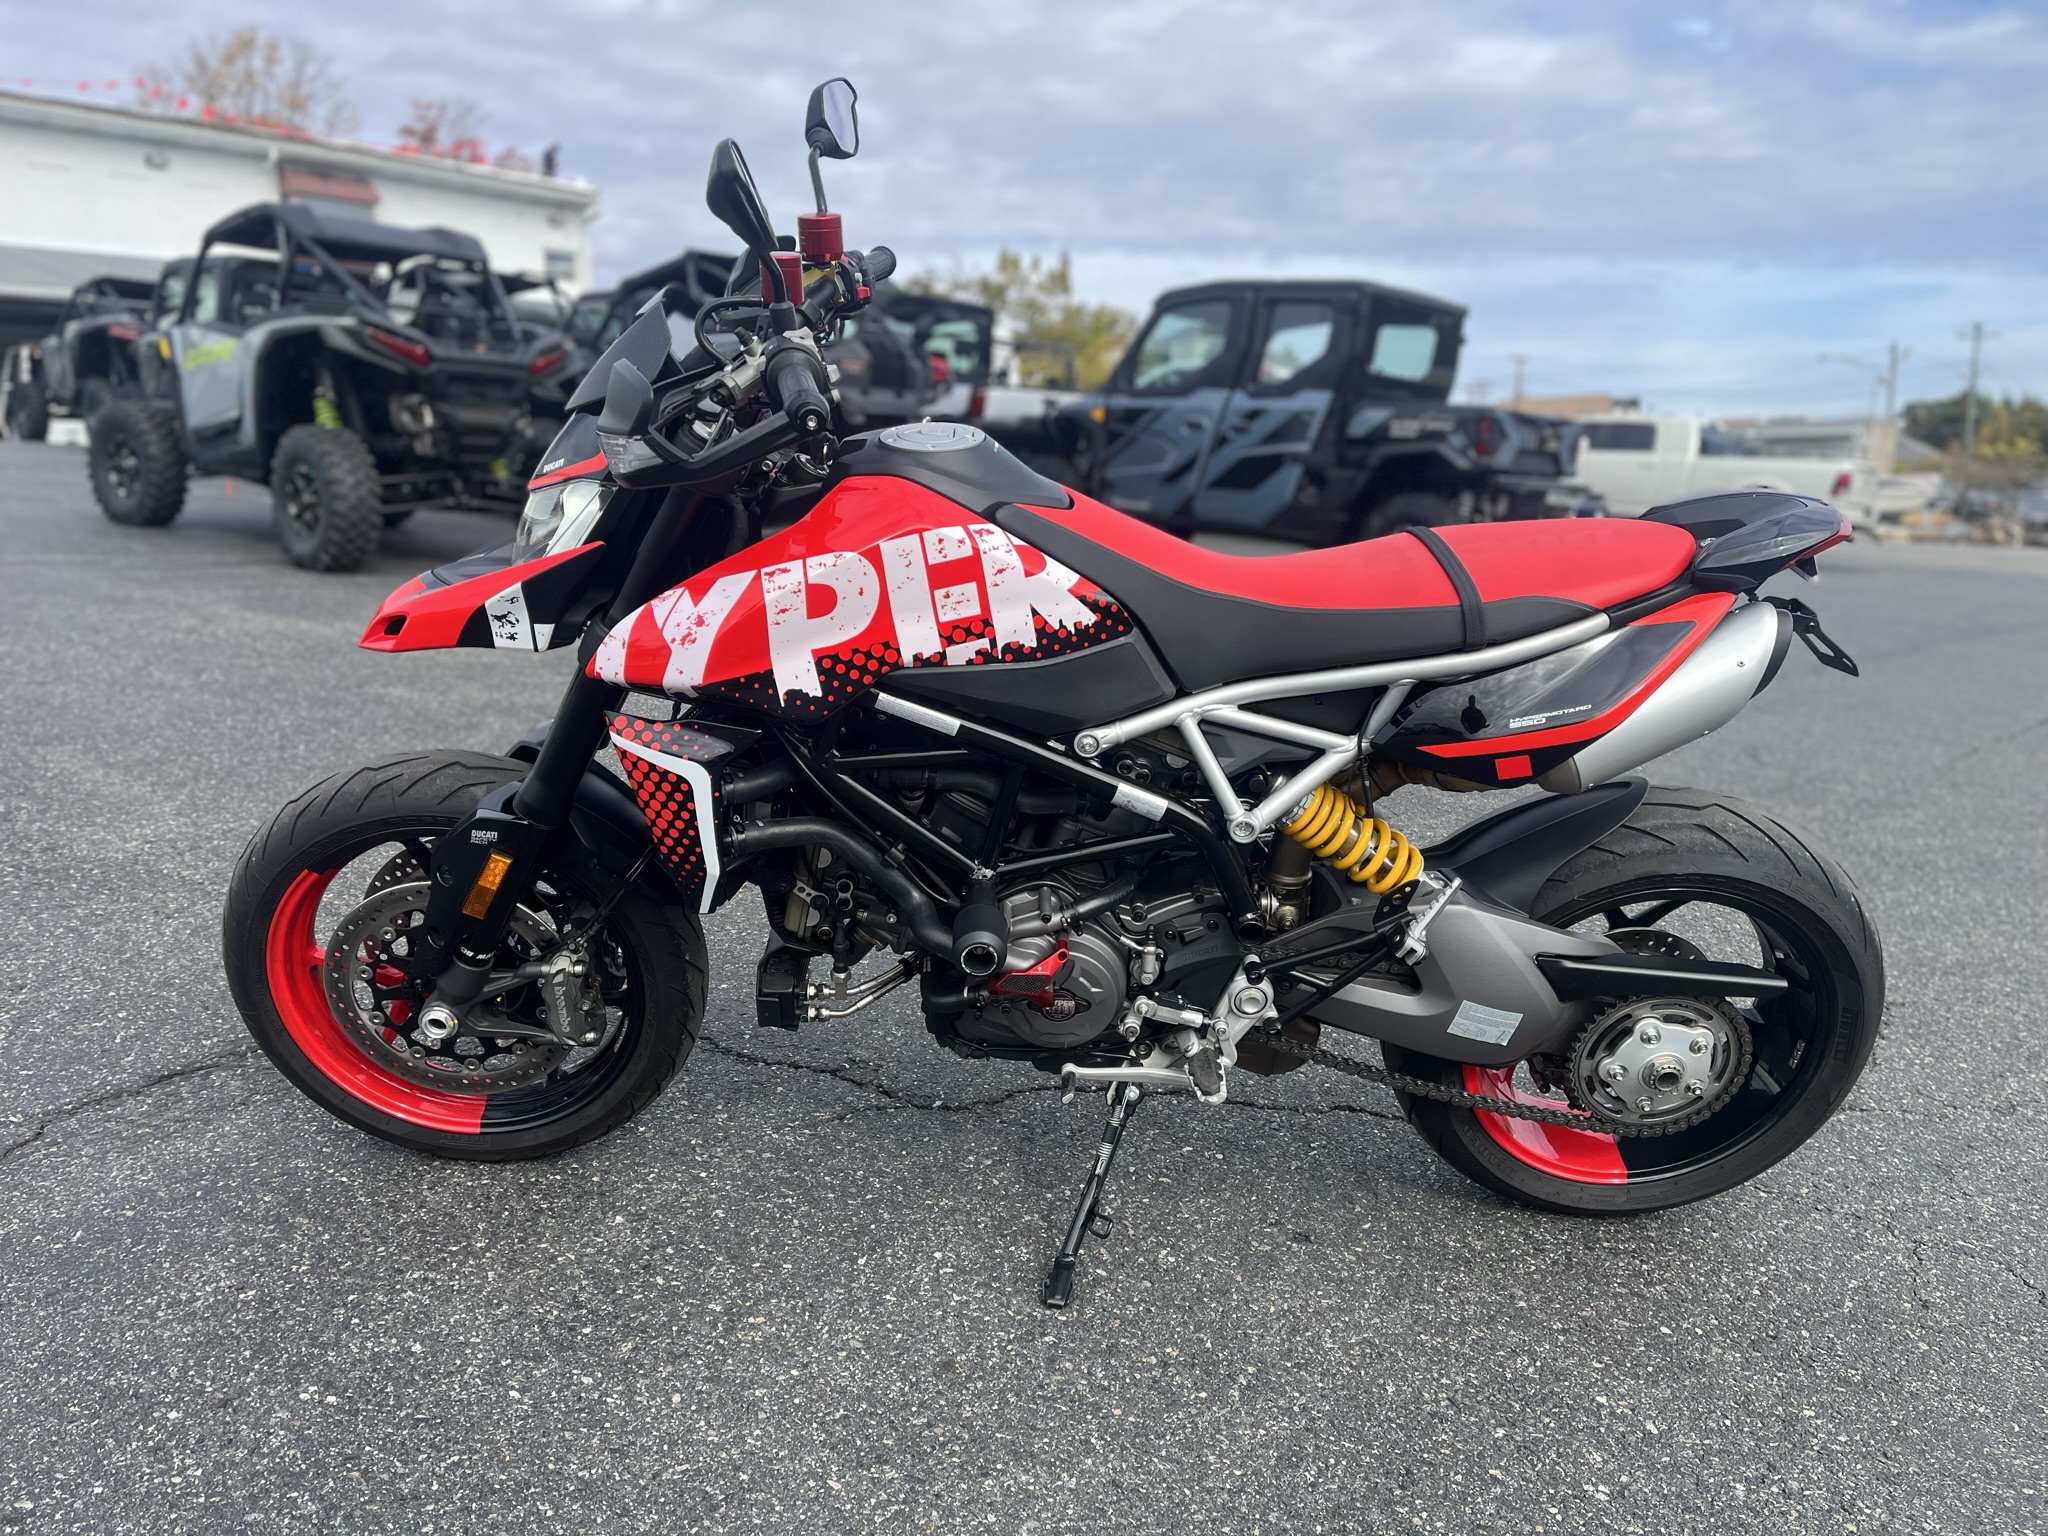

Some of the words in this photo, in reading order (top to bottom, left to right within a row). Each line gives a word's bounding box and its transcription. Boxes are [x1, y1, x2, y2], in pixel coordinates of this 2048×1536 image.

[543, 458, 565, 473] DUCATI
[1509, 704, 1592, 723] HYPERMOTARD
[1509, 717, 1546, 729] 950
[471, 829, 498, 839] DUCATI
[553, 986, 572, 1033] brembo
